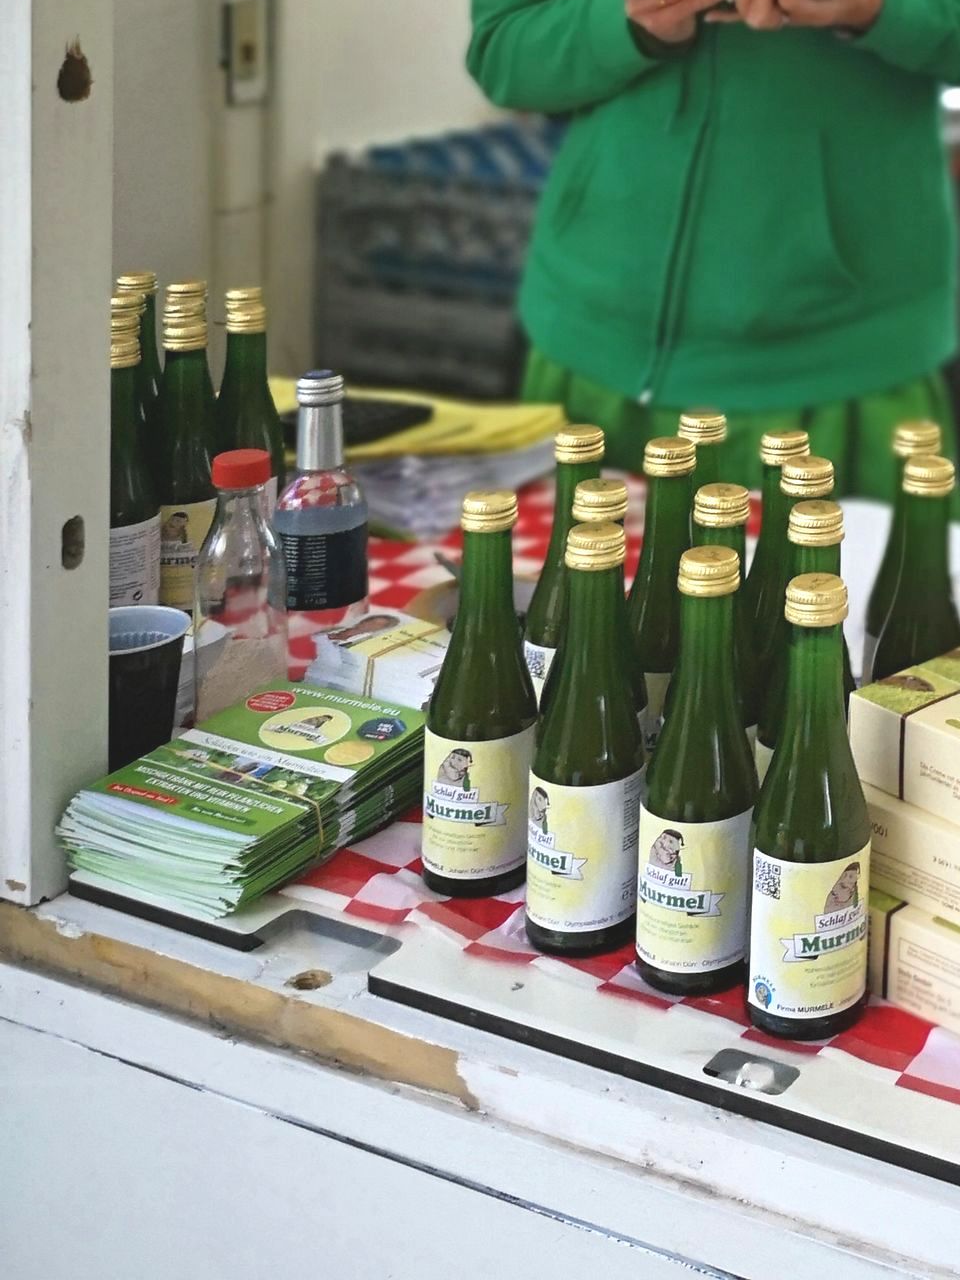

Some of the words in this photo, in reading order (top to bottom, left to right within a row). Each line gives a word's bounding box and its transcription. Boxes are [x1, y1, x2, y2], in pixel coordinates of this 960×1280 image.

[433, 785, 456, 800] Schlaf
[457, 791, 476, 802] gut!
[425, 796, 492, 820] Murmel
[646, 866, 668, 885] Schlaf
[669, 877, 688, 887] gut!
[639, 877, 705, 910] Murmel
[818, 912, 849, 929] Schlaf
[801, 922, 866, 954] Murme
[777, 1004, 796, 1013] Firma
[798, 1001, 834, 1013] MURMELE
